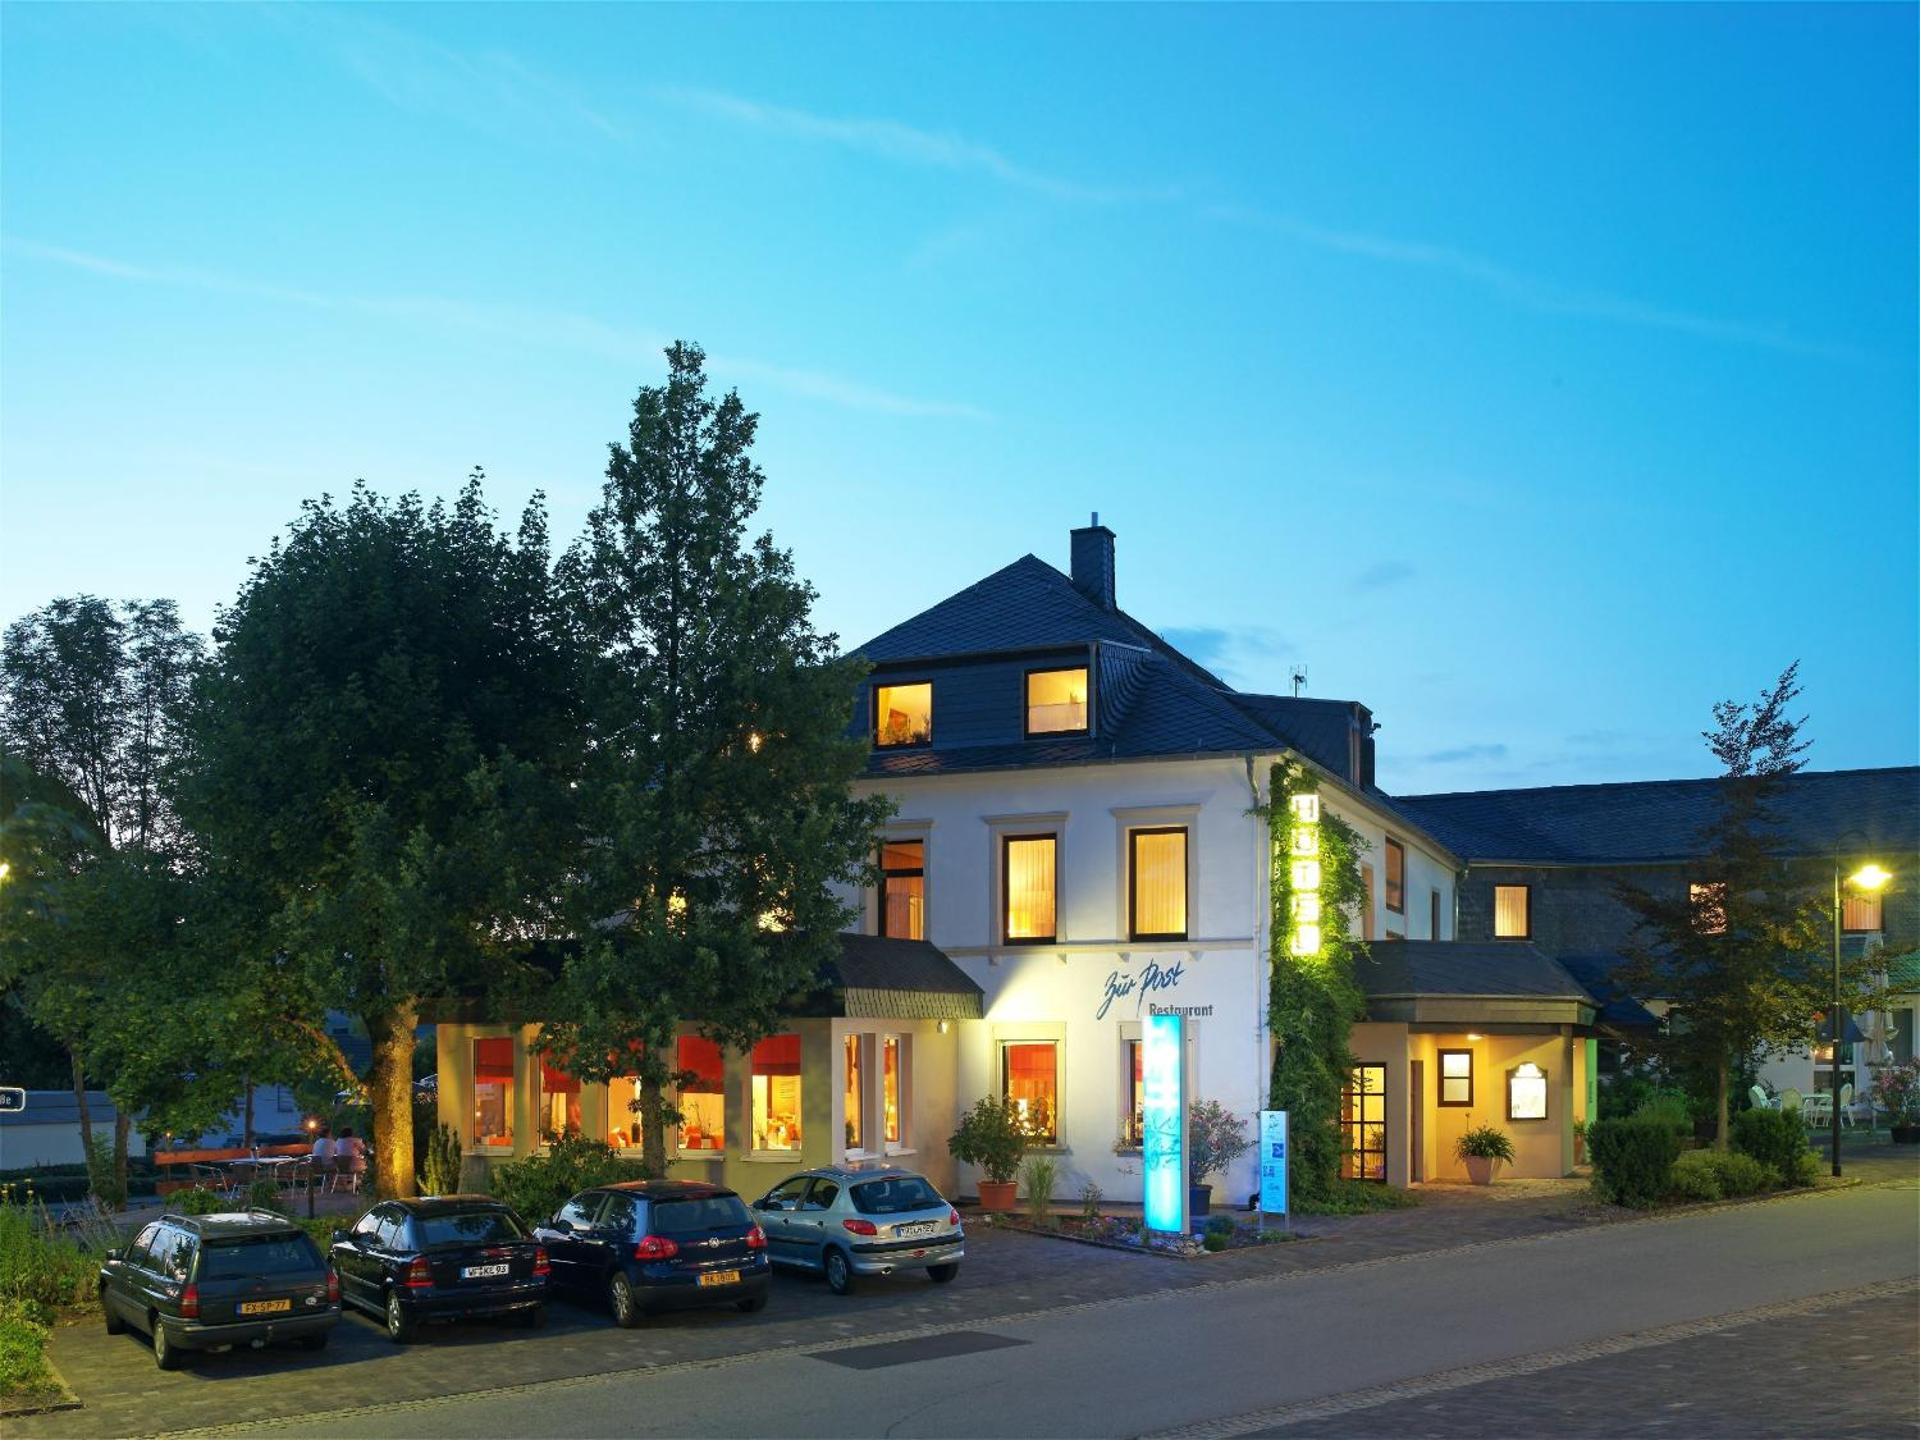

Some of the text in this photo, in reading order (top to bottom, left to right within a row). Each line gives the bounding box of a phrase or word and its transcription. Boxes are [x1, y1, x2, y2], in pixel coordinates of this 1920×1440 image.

[1294, 797, 1318, 951] HOTEL
[1136, 958, 1185, 1018] Post
[1149, 1003, 1214, 1016] Restaurant
